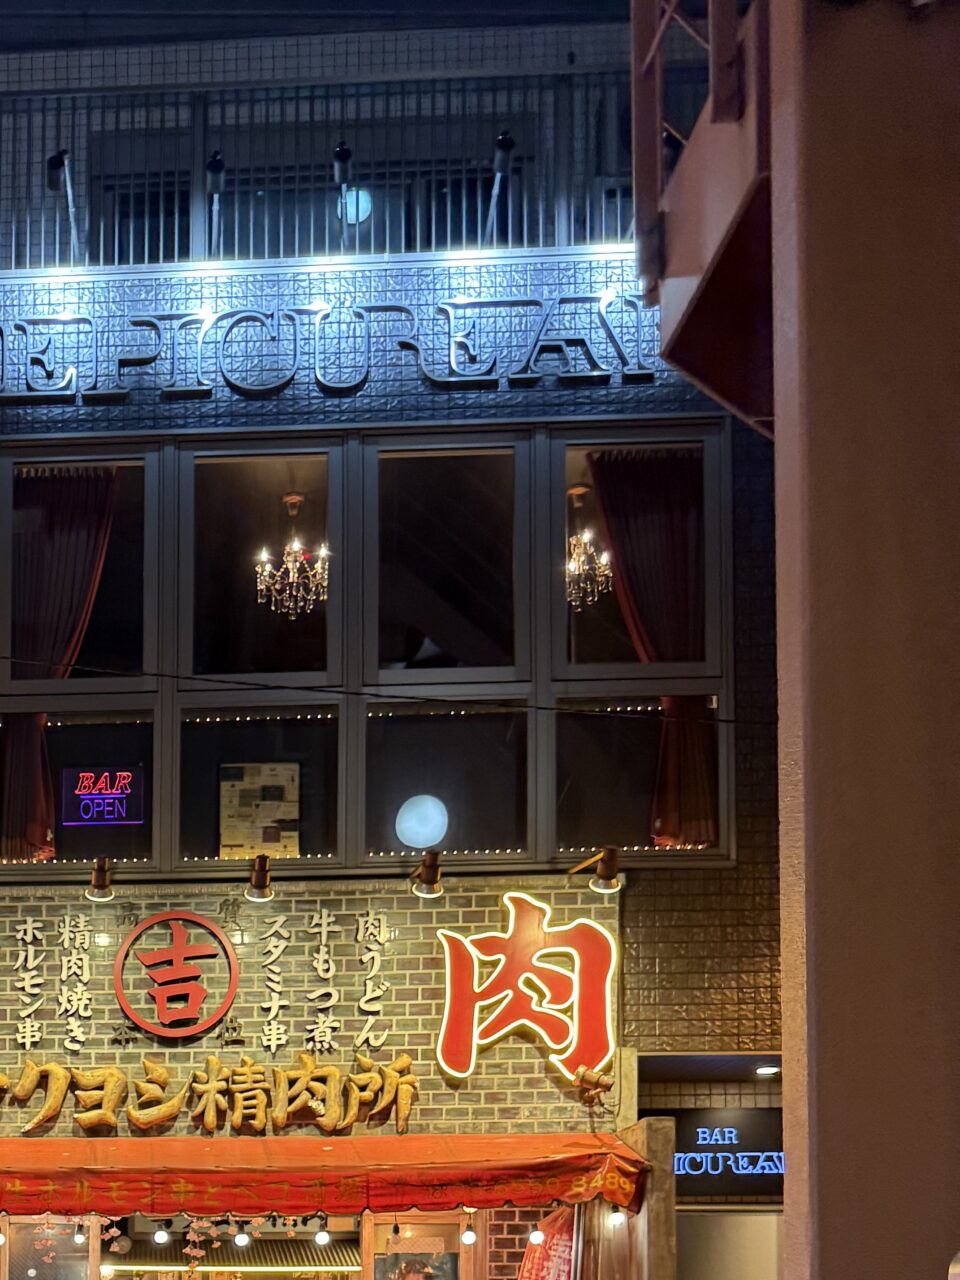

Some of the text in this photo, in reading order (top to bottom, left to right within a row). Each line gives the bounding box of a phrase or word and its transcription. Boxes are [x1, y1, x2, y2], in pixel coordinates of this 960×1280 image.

[74, 772, 132, 794] BAR
[80, 799, 126, 819] OPEN
[13, 917, 46, 1051] ホルモン串
[58, 914, 93, 1051] 精肉焼き
[260, 915, 290, 1053] スタミナ串
[306, 908, 342, 1050] 牛もつ煮
[355, 910, 390, 1047] 肉うどん
[437, 891, 618, 1079] 肉
[696, 1128, 739, 1144] BAR
